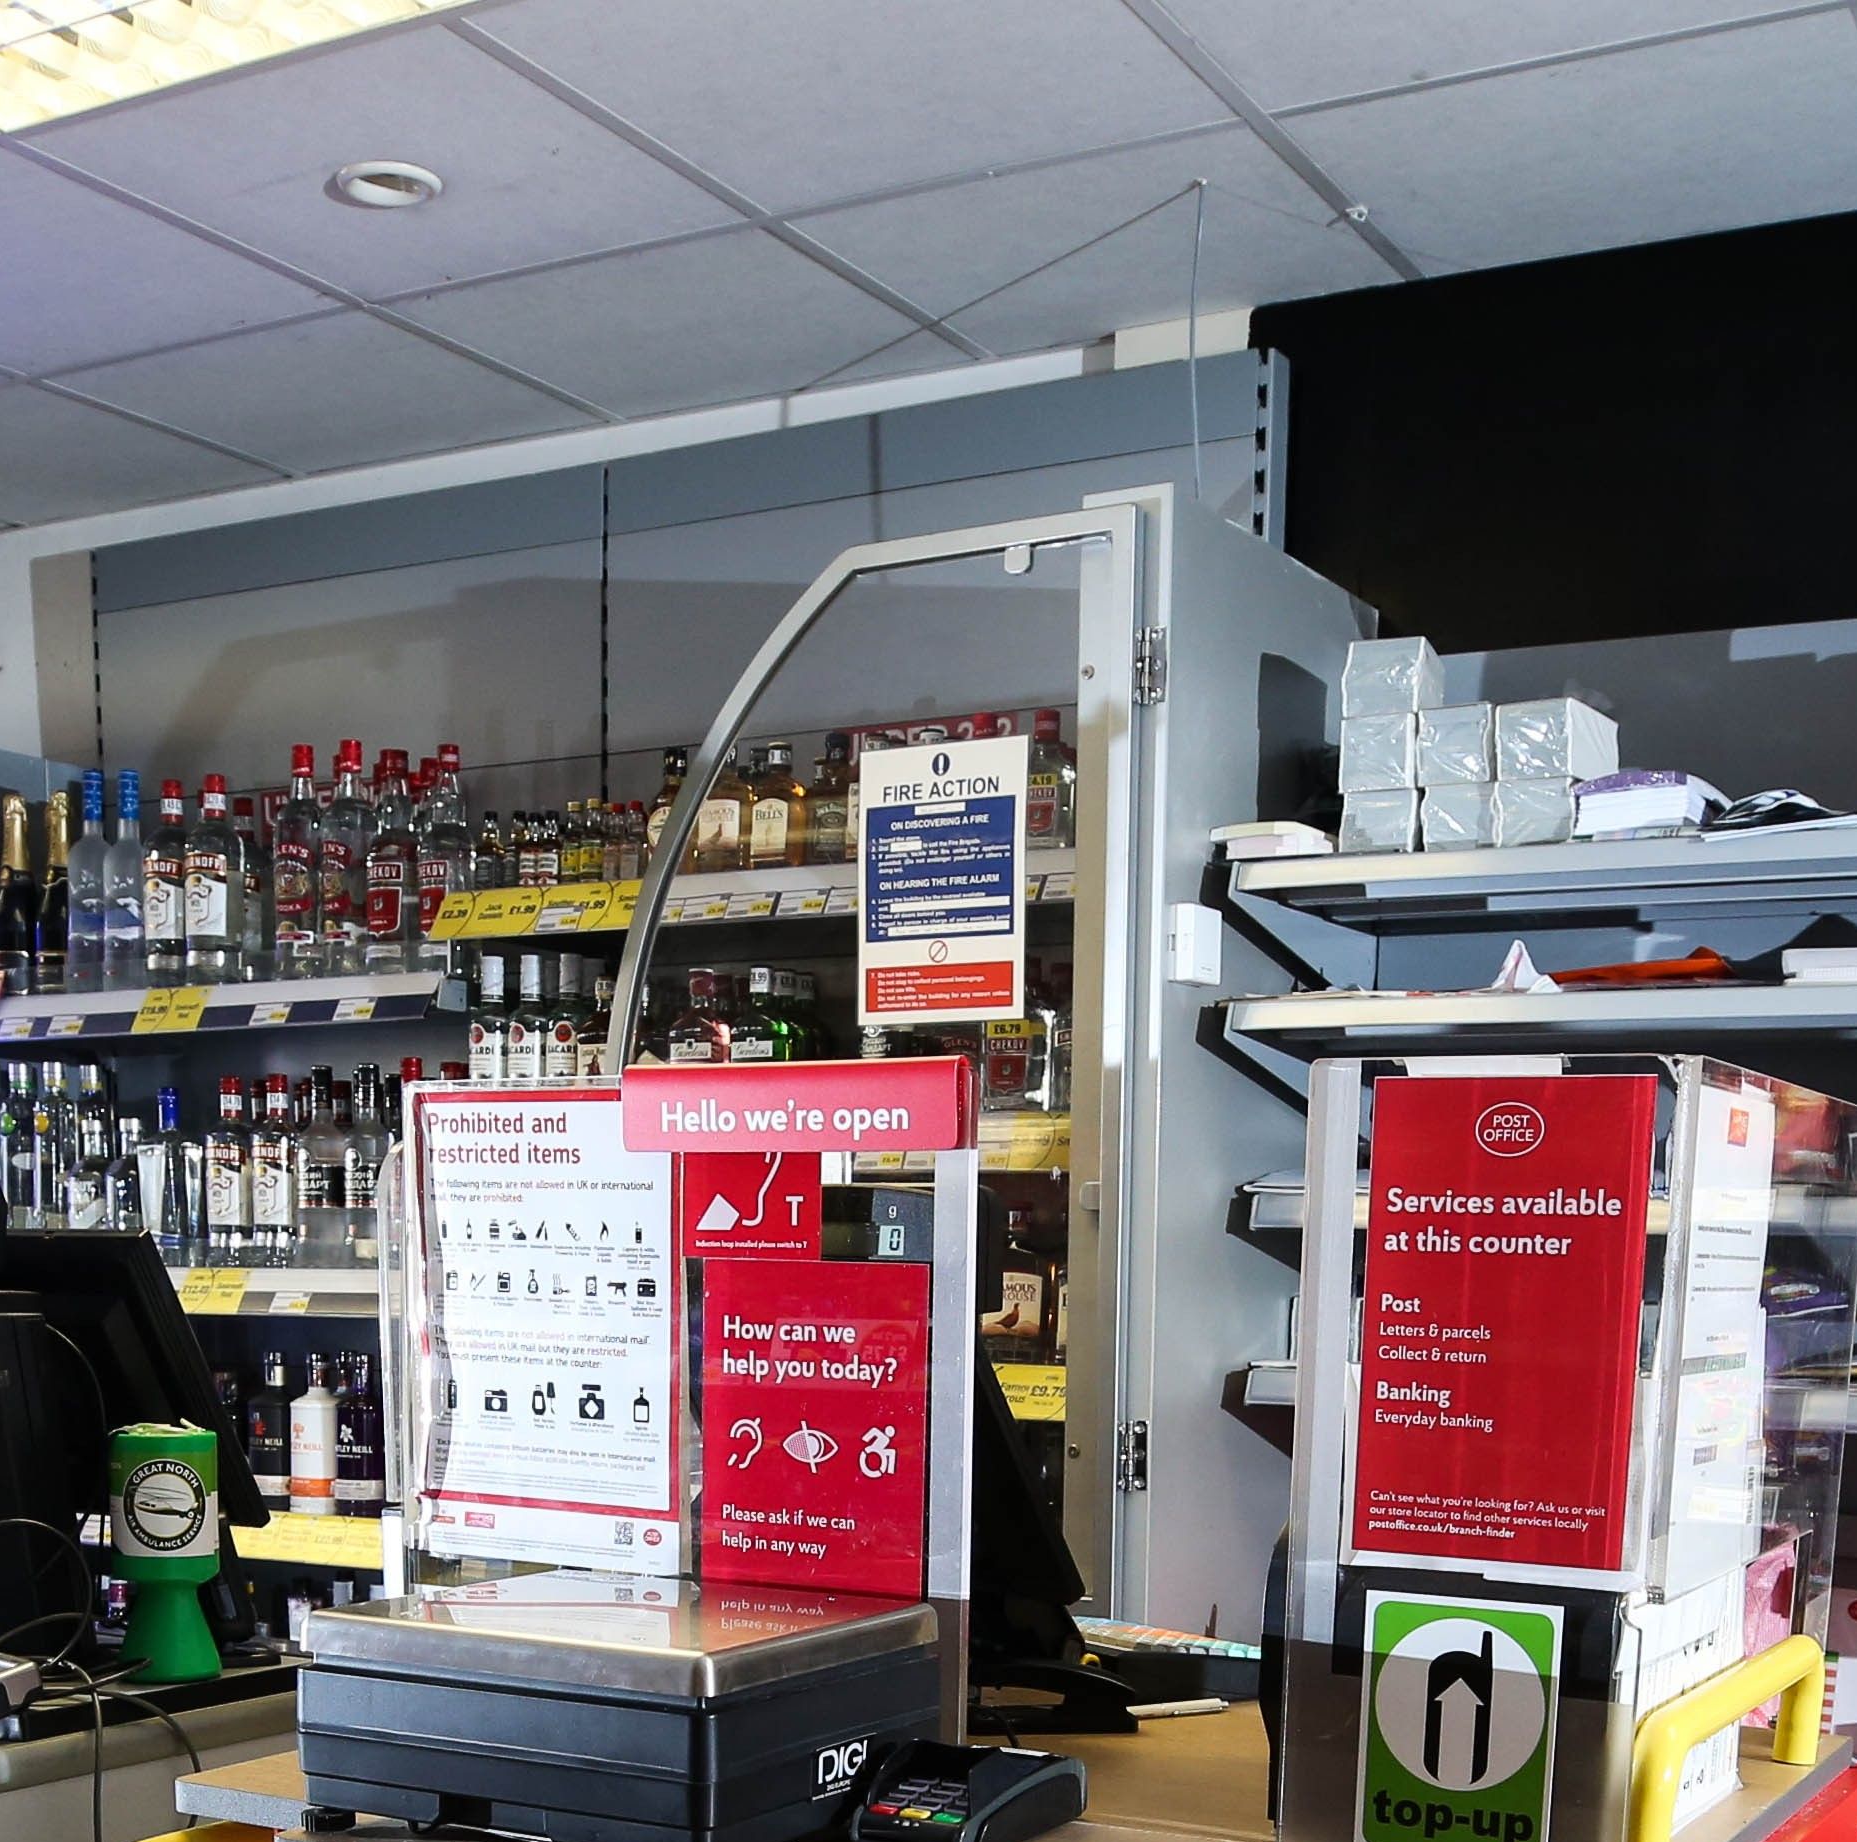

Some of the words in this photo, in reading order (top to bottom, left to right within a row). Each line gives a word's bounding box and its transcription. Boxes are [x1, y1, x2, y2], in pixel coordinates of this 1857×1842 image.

[883, 784, 923, 802] FIRE
[929, 776, 1000, 798] ACTION
[891, 821, 903, 830] ON
[905, 818, 960, 830] DISCOVERING
[963, 817, 969, 825] A
[971, 814, 989, 823] FIRE
[990, 1038, 1025, 1051] CHEKOV
[428, 1112, 524, 1133] Prohibited
[532, 1112, 567, 1133] and
[660, 1102, 735, 1132] Hello
[743, 1100, 824, 1132] we're
[833, 1106, 910, 1140] open
[1493, 1115, 1530, 1128] POST
[1483, 1129, 1534, 1142] OFFICE
[429, 1142, 519, 1164] restricted
[527, 1142, 581, 1164] items
[786, 1196, 803, 1226] T
[1387, 1187, 1494, 1214] Services
[1502, 1188, 1622, 1217] available
[1385, 1232, 1408, 1251] at
[1417, 1226, 1461, 1252] this
[1469, 1234, 1571, 1255] counter
[1381, 1294, 1420, 1313] Post
[723, 1315, 773, 1340] How
[779, 1322, 816, 1340] can
[823, 1324, 855, 1342] we
[1380, 1323, 1425, 1337] Letters
[1429, 1323, 1438, 1337] &
[1442, 1325, 1491, 1342] parcels
[1379, 1346, 1428, 1361] Collect
[1432, 1349, 1440, 1361] &
[1445, 1350, 1486, 1364] return
[723, 1350, 769, 1382] help
[774, 1358, 814, 1384] you
[821, 1354, 897, 1388] today?
[1377, 1381, 1451, 1408] Banking
[1375, 1410, 1437, 1428] Everyday
[1440, 1413, 1494, 1432] banking
[133, 1463, 163, 1484] GREAT
[166, 1463, 199, 1488] NORTH
[1370, 1490, 1396, 1501] Can't
[1398, 1495, 1414, 1503] see
[1416, 1495, 1440, 1505] what
[1443, 1496, 1472, 1508] you're
[1475, 1498, 1511, 1512] looking
[1514, 1500, 1534, 1511] for?
[1536, 1504, 1554, 1513] Ask
[1558, 1506, 1569, 1514] us
[1585, 1507, 1605, 1516] visit
[722, 1505, 765, 1526] Please
[769, 1507, 791, 1526] ask
[793, 1507, 803, 1526] if
[806, 1514, 827, 1528] we
[831, 1516, 855, 1530] can
[135, 1529, 182, 1547] AMBULANCE
[1369, 1520, 1515, 1539] postoffice.co.uk/branch-finder
[722, 1532, 752, 1553] help
[756, 1534, 766, 1551] in
[770, 1539, 795, 1557] any
[799, 1542, 826, 1558] way
